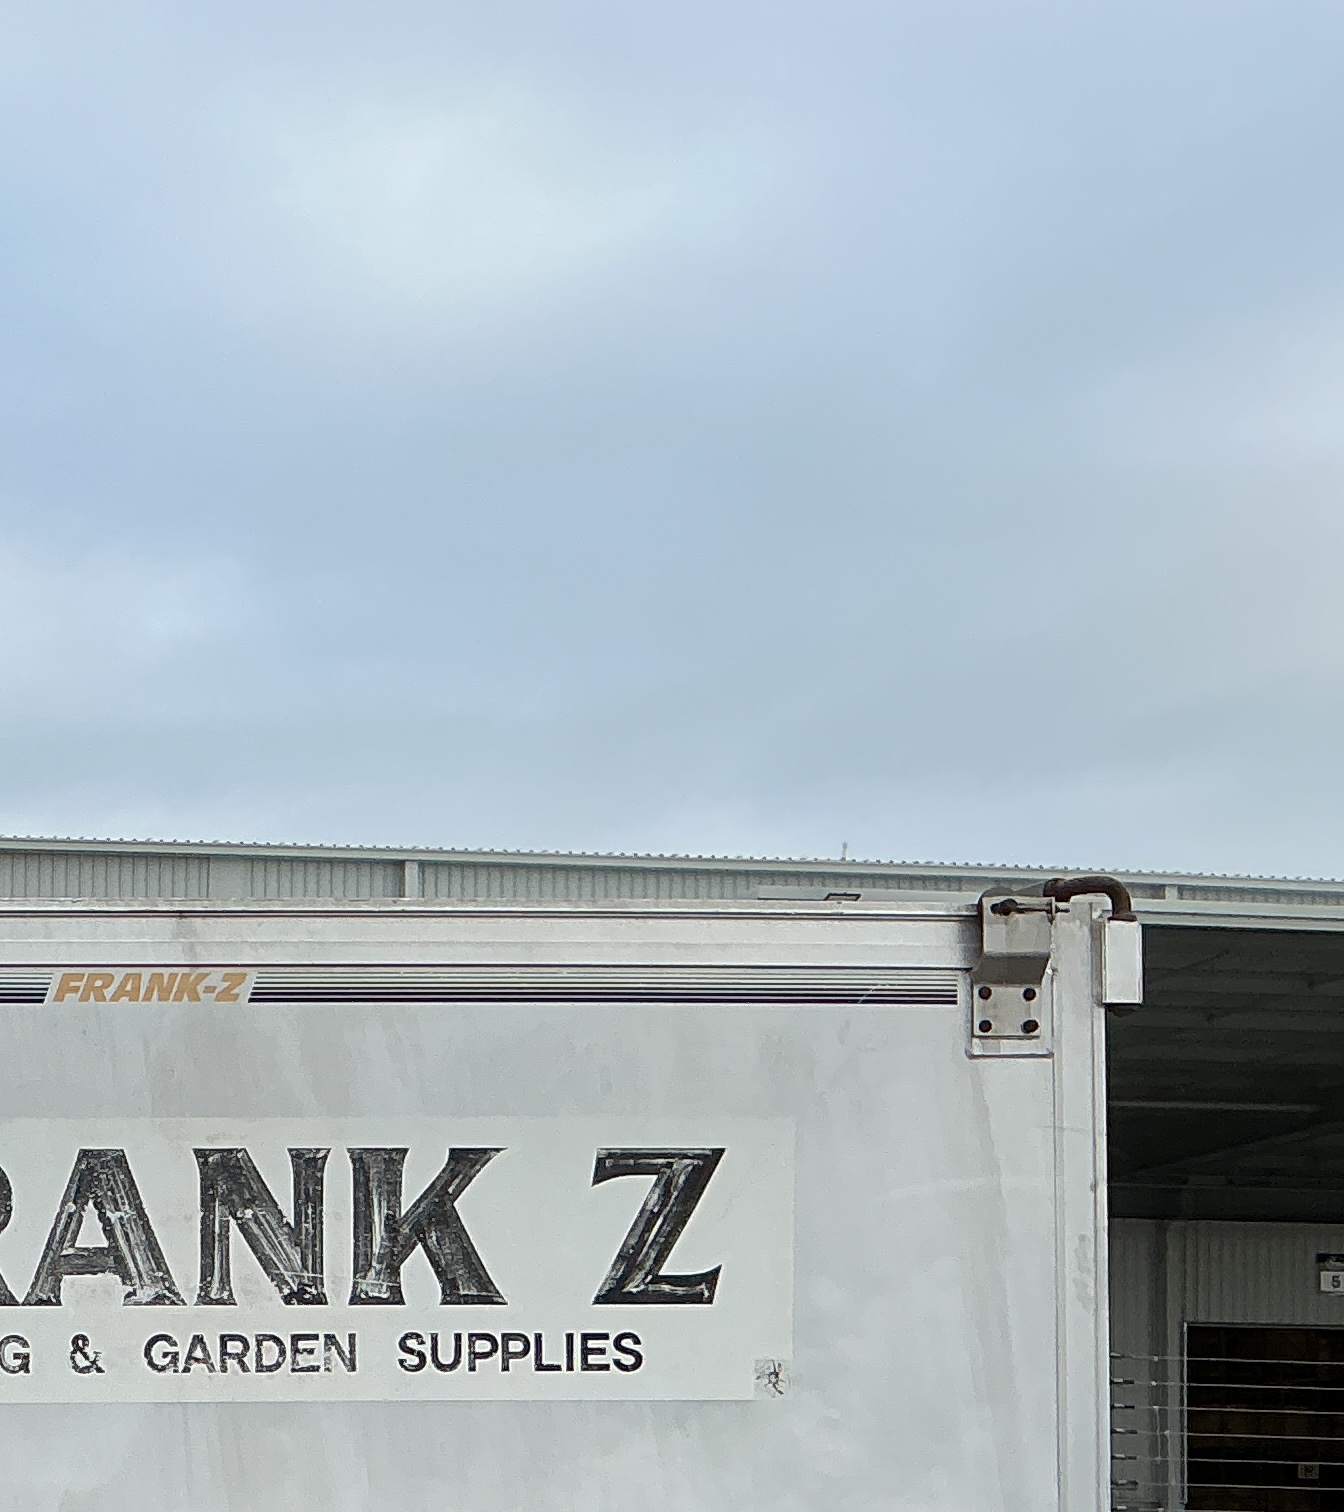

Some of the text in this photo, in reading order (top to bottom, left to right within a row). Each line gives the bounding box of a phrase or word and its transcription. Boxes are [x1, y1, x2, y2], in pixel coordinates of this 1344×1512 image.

[53, 972, 248, 1003] FRANK-Z
[591, 1147, 726, 1306] Z
[69, 1333, 104, 1375] &
[143, 1333, 357, 1374] GARDEN
[398, 1332, 643, 1373] SUPPLIES
